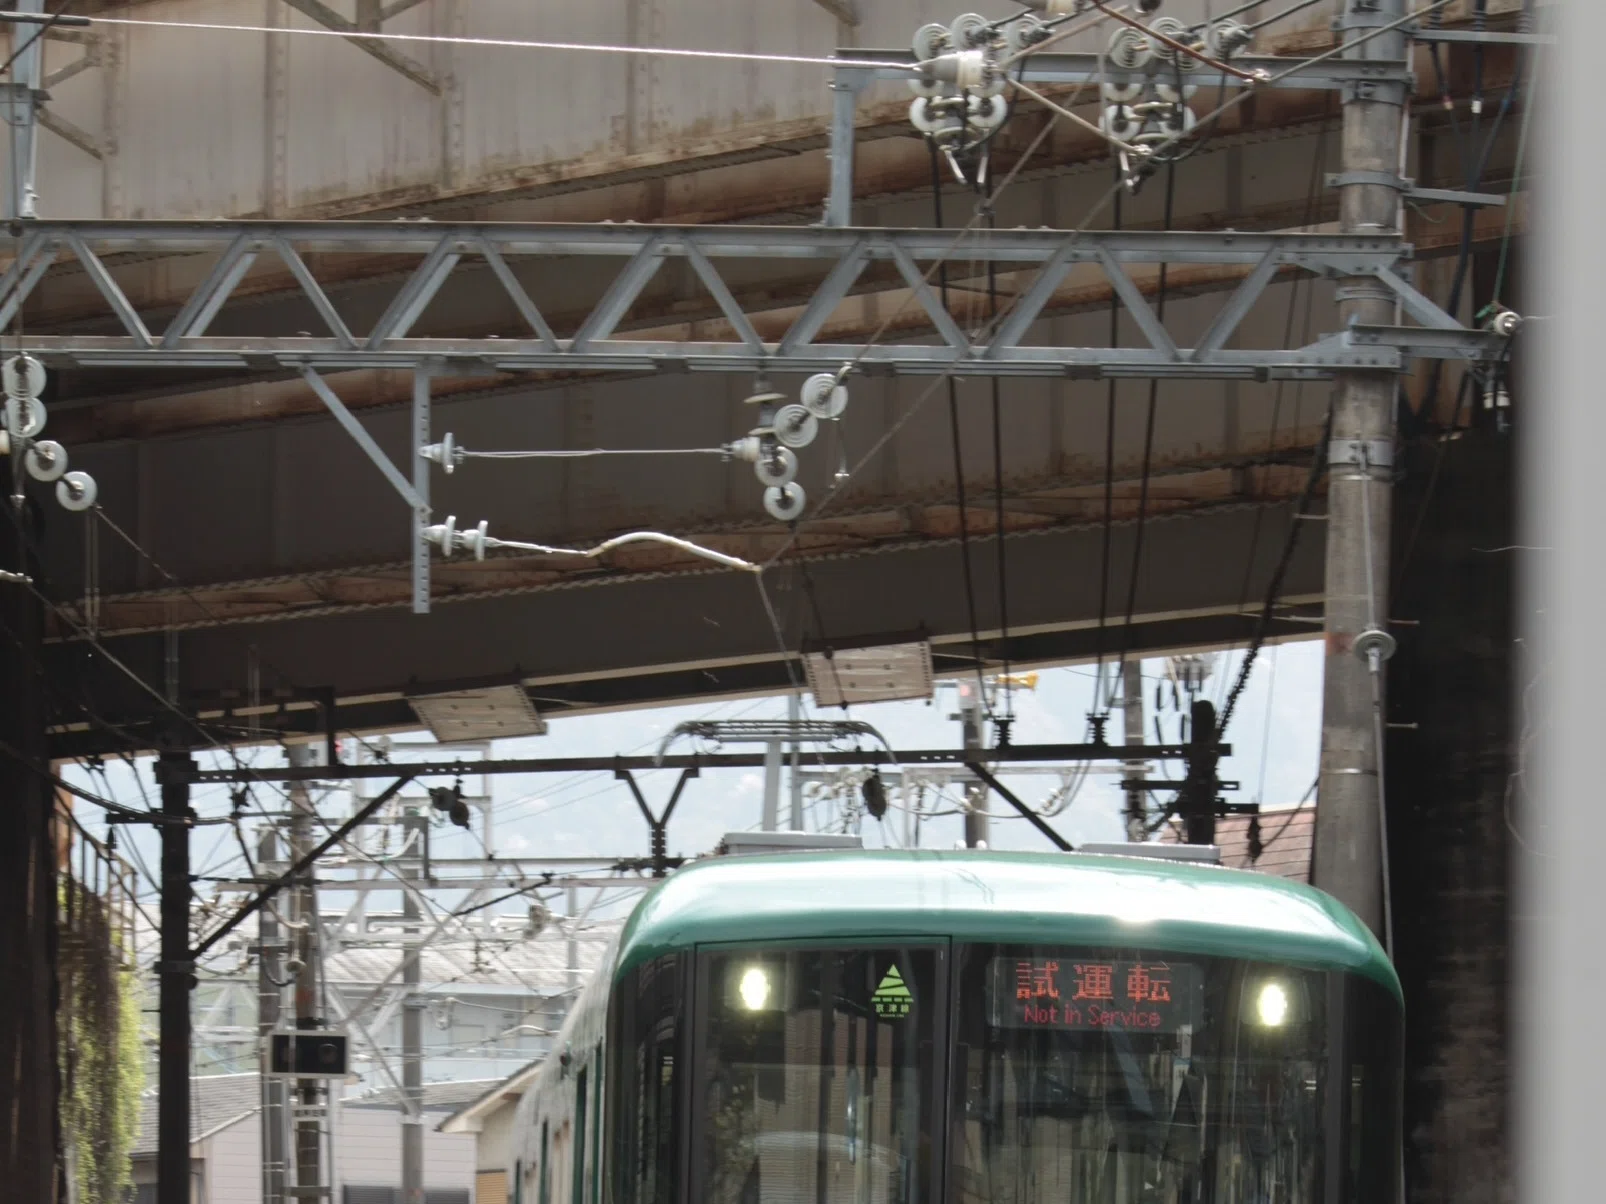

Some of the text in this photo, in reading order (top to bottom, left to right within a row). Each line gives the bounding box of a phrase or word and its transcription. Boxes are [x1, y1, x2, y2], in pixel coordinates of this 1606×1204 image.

[1015, 960, 1172, 1003] 試運転
[1024, 1003, 1161, 1027] Not in Service
